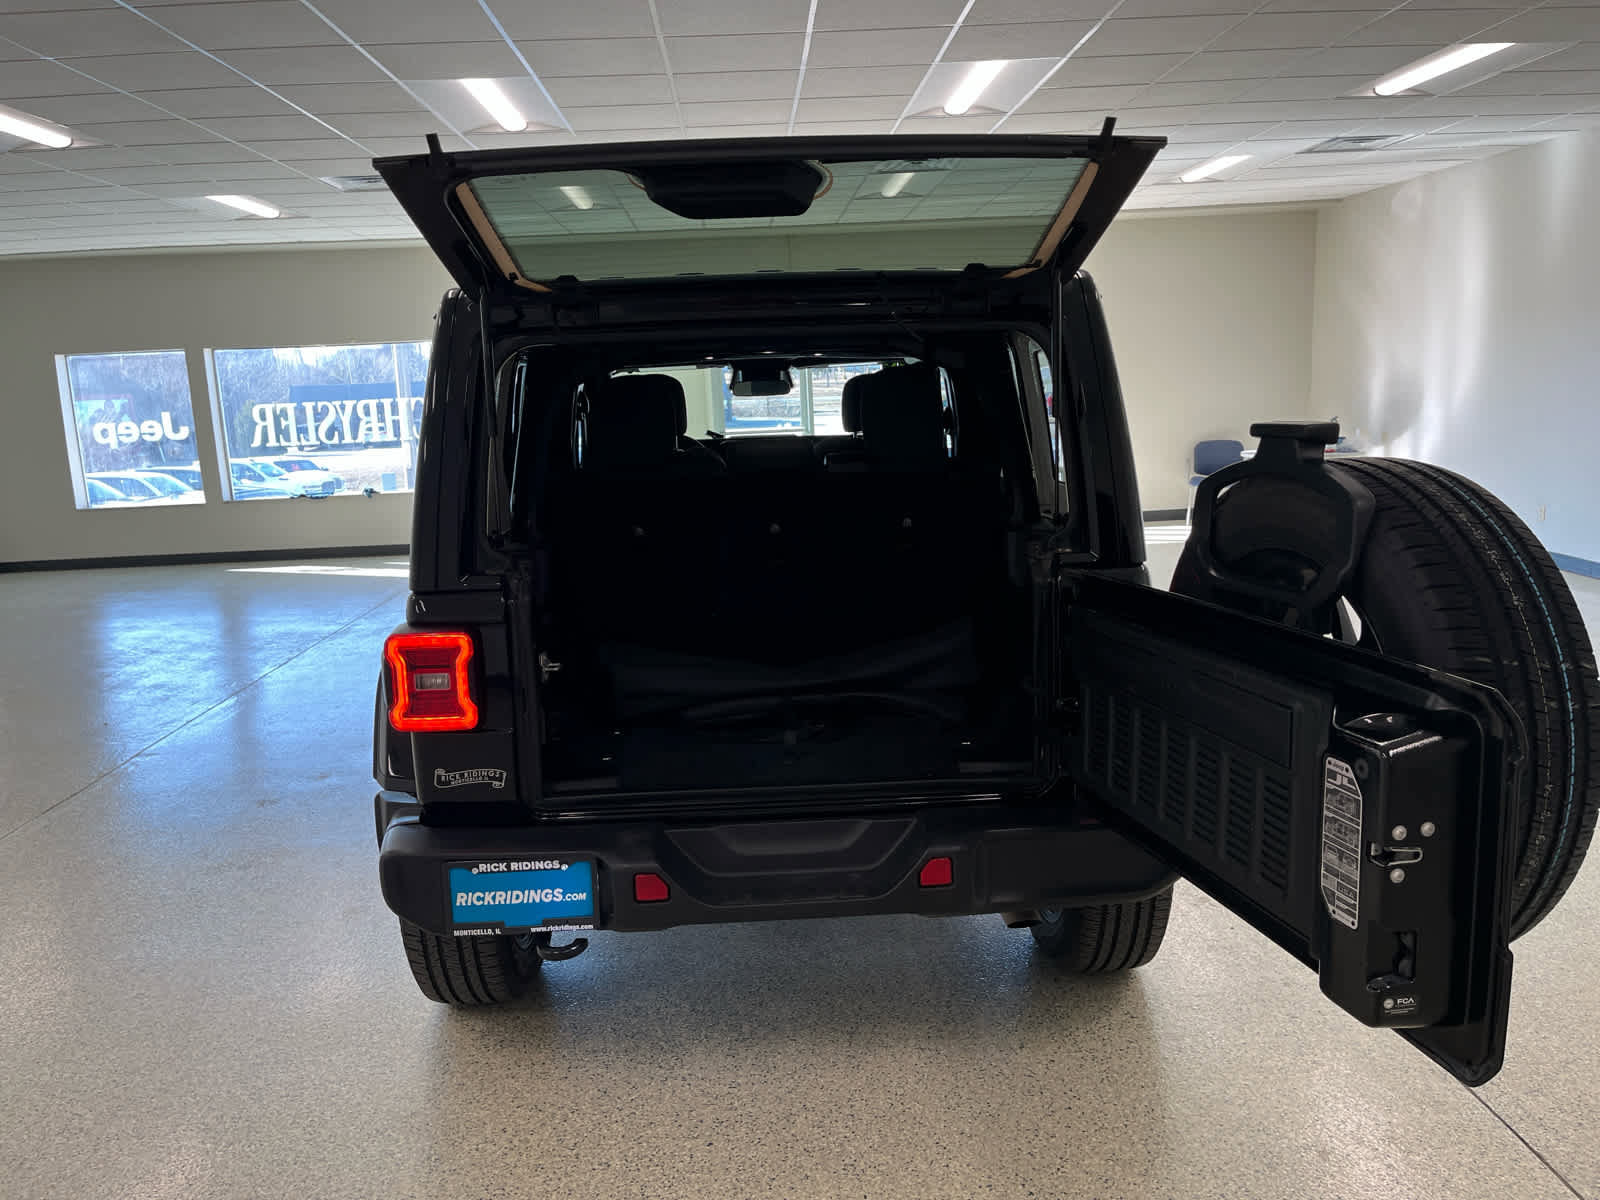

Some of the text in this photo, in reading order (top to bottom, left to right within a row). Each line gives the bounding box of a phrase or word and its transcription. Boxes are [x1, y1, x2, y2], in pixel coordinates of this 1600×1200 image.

[478, 859, 561, 873] RICK RIDINGS
[455, 887, 587, 907] RICKRIDINGS.COM
[453, 928, 494, 937] MONTICELLO,
[530, 923, 594, 933] www.rickridings.com
[1397, 997, 1415, 1005] FCA
